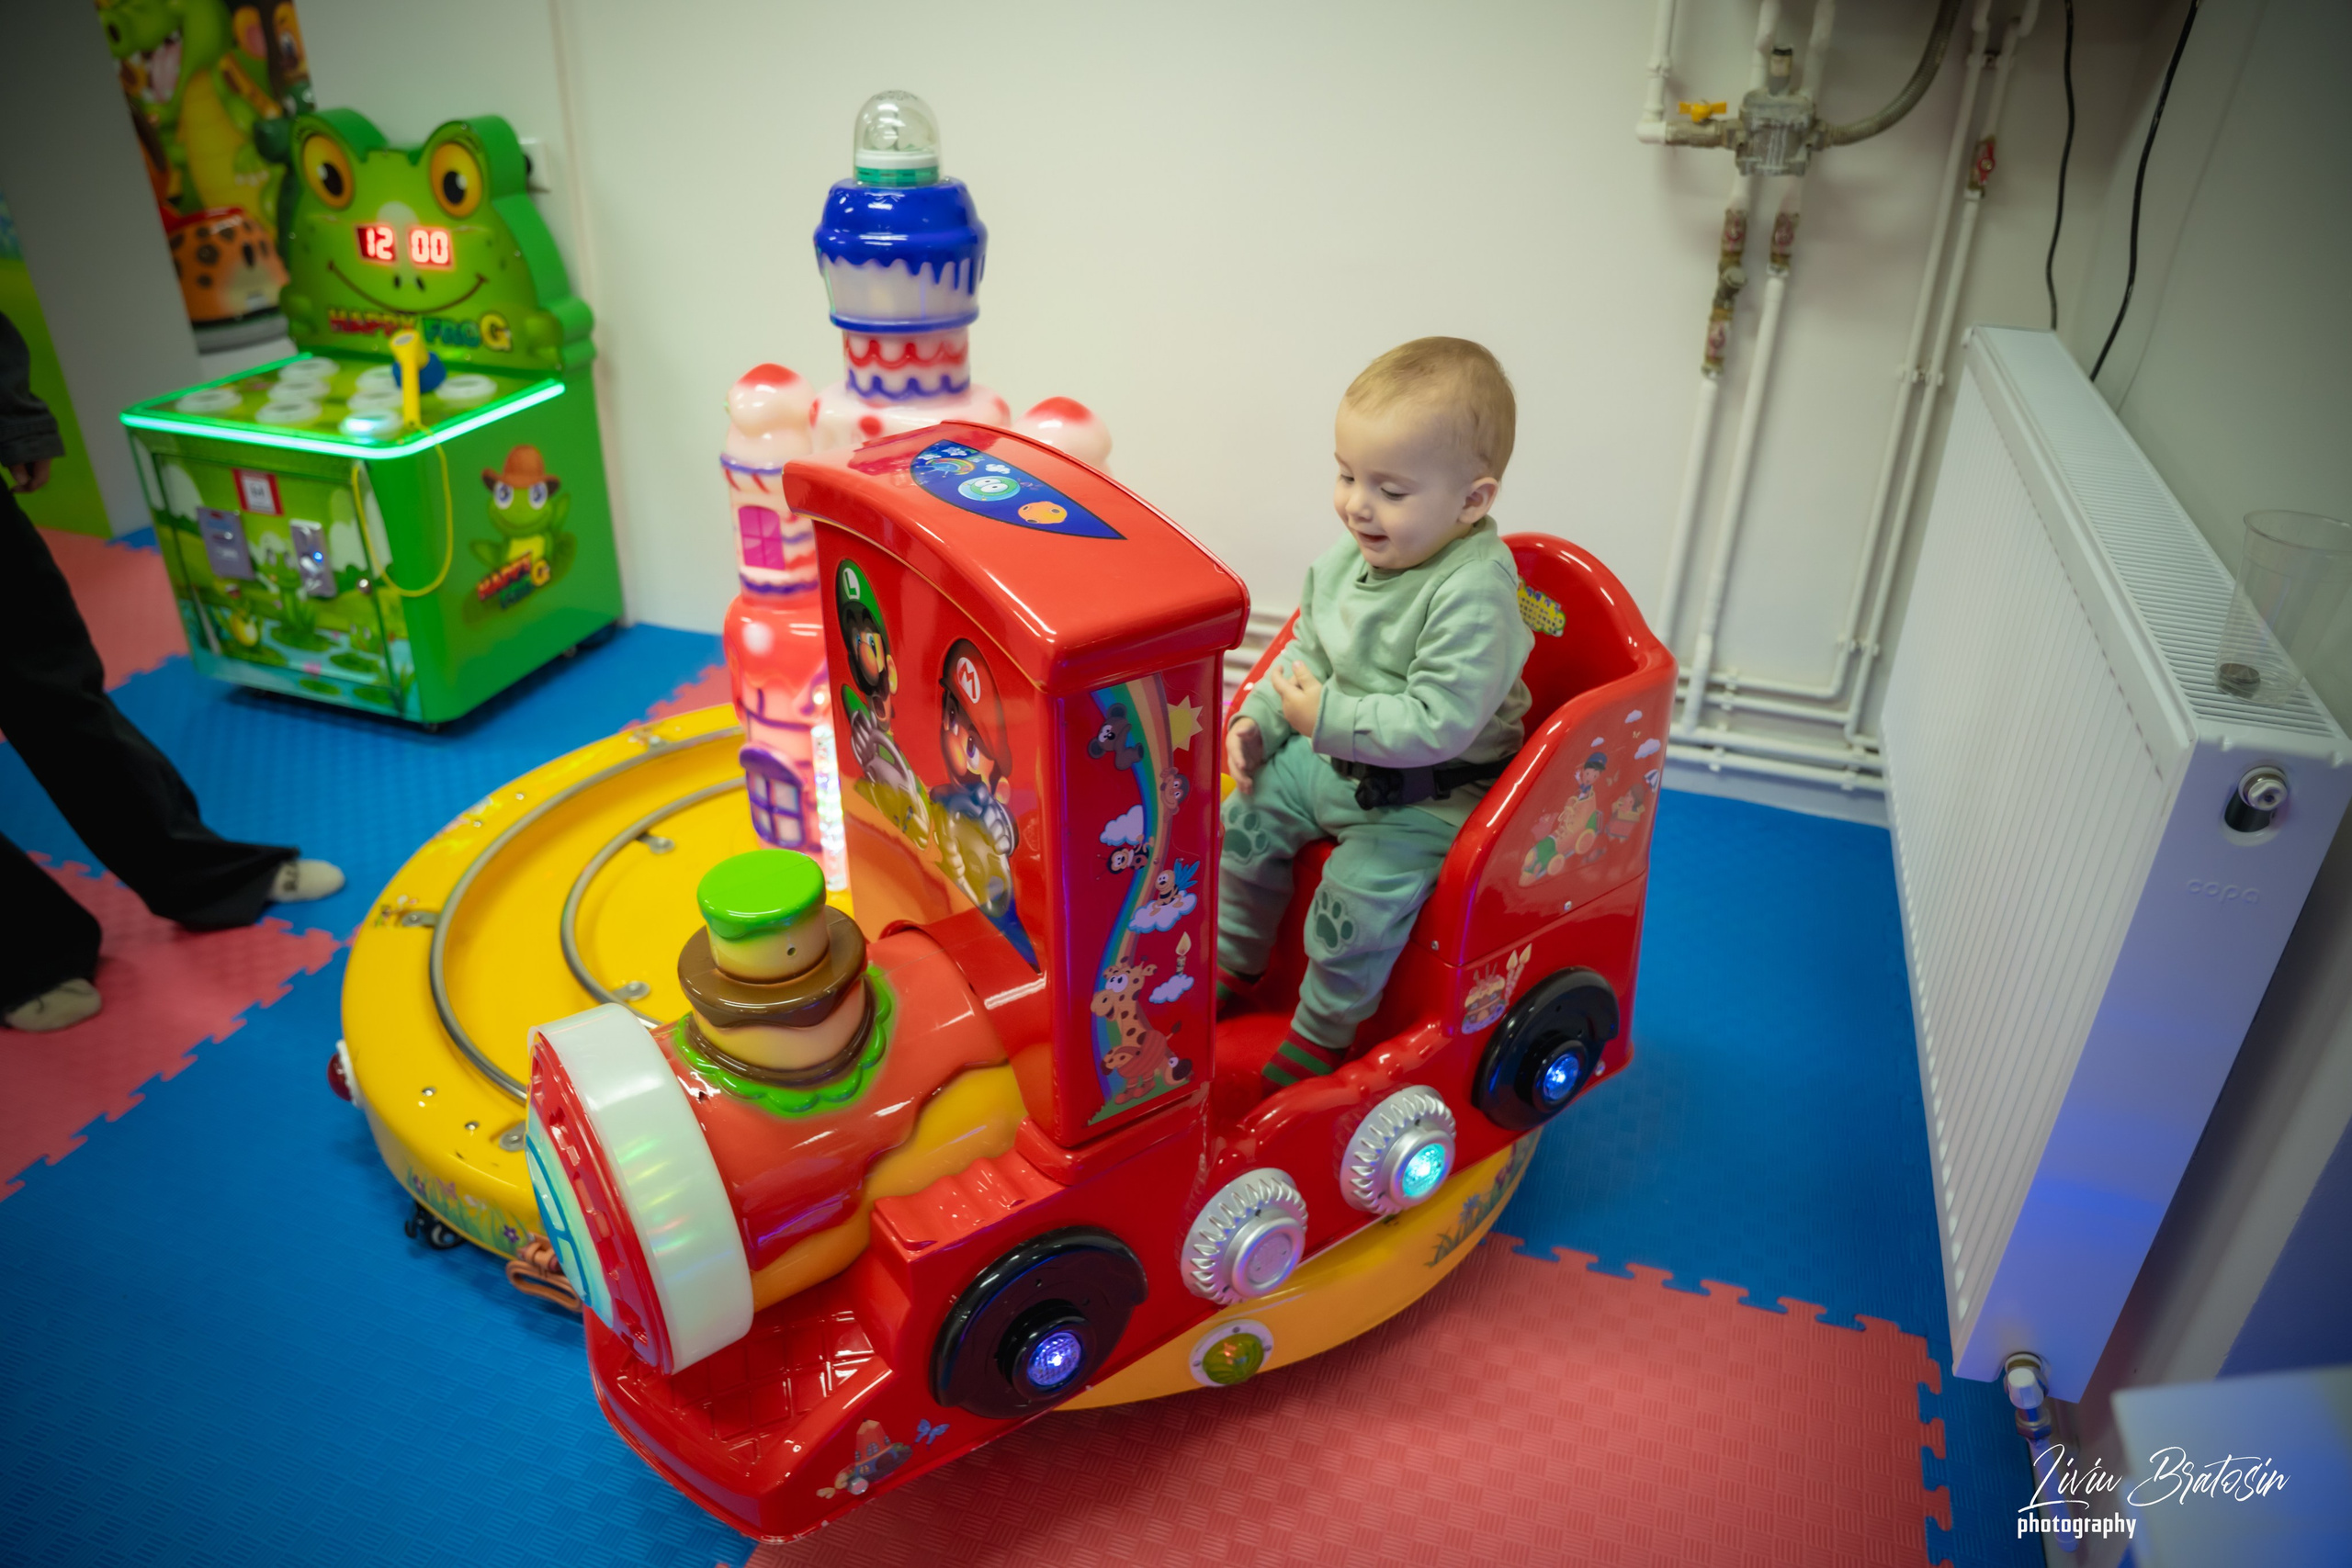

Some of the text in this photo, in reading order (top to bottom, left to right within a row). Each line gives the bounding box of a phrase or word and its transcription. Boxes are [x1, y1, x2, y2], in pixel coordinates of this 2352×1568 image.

[366, 226, 449, 265] 12 00
[843, 570, 858, 596] L
[958, 660, 977, 700] M
